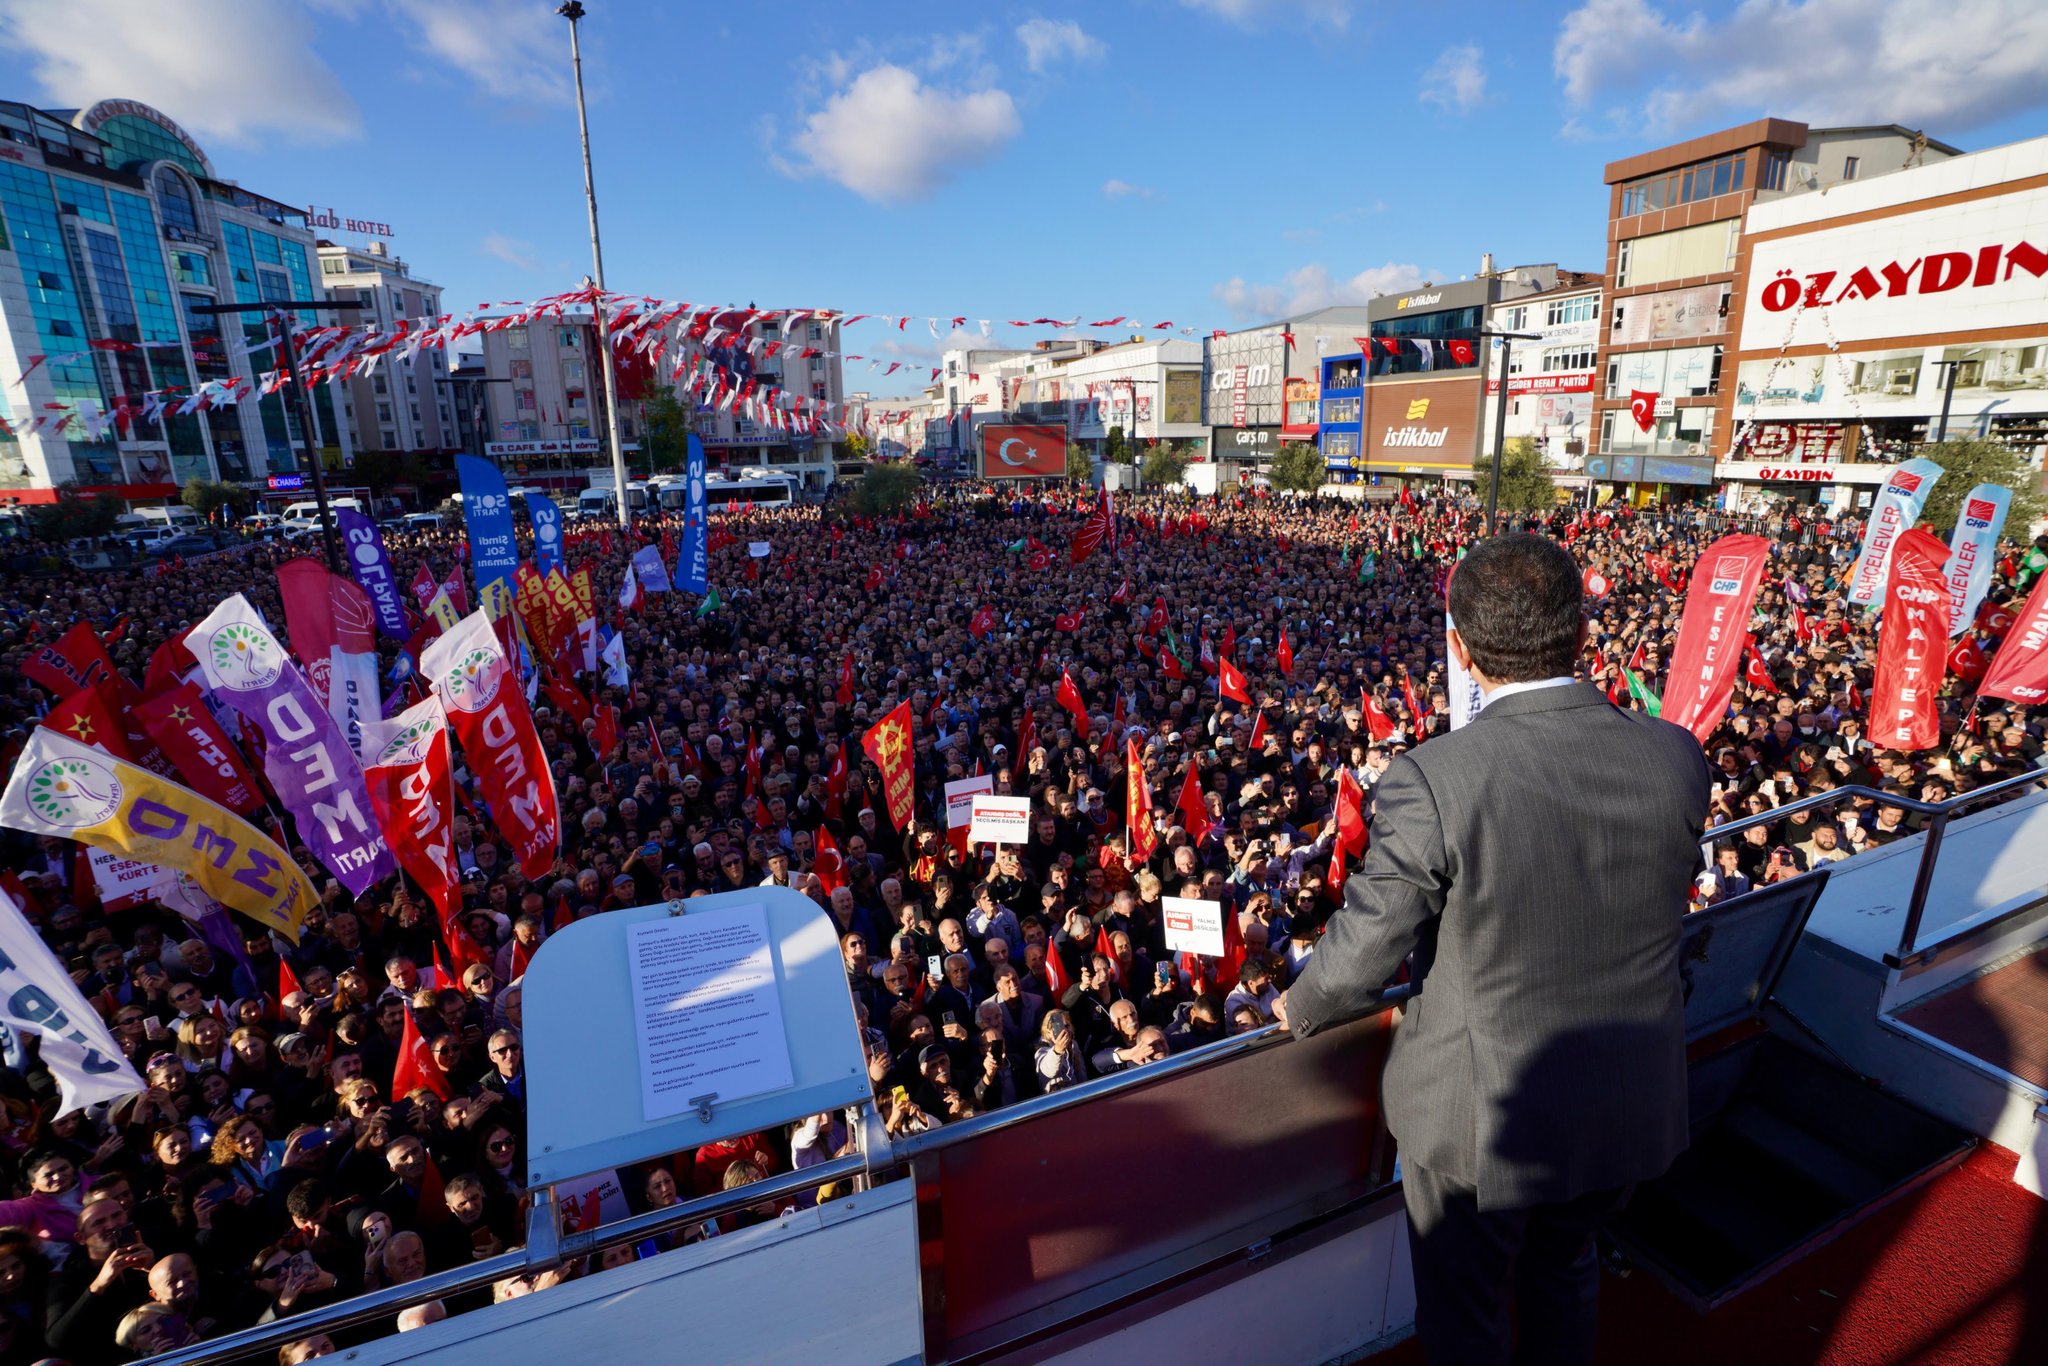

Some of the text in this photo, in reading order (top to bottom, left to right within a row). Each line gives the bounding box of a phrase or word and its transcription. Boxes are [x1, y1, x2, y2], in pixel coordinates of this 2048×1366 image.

[345, 218, 395, 238] HOTEL
[1760, 240, 2048, 312] ÖZAYDIN
[1406, 292, 1442, 309] istikbal
[1506, 373, 1589, 390] ENİDEN REFAH PARTİSİ
[1383, 427, 1448, 448] istikbal
[490, 444, 504, 453] ES
[507, 444, 536, 452] CAFE
[268, 477, 302, 488] EXCHANGE
[1887, 486, 1912, 497] CHP
[1966, 518, 1990, 530] CHP
[1855, 505, 1900, 602] BAHÇELİEVLER
[1714, 580, 1738, 592] CHP
[1896, 586, 1940, 604] CHP
[1895, 607, 1926, 742] MALTEPE
[94, 854, 117, 866] HER
